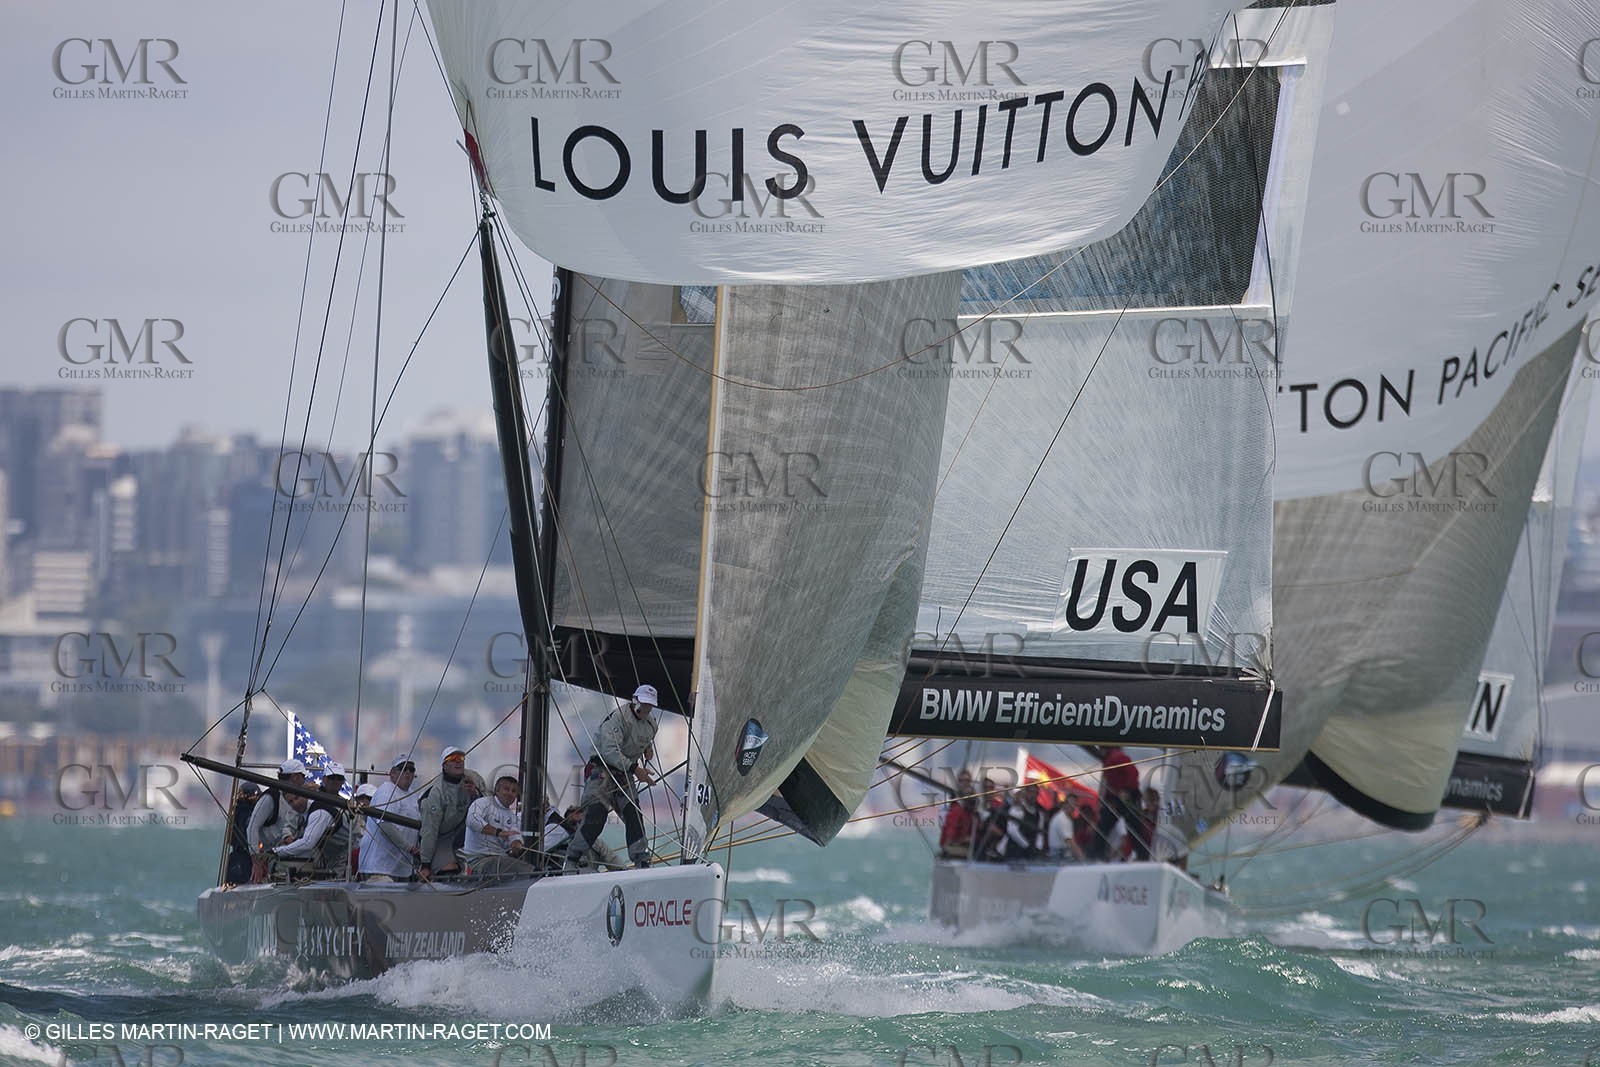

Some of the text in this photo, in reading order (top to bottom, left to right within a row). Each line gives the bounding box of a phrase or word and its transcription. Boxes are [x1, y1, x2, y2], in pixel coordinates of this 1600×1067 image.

[531, 116, 809, 204] LOUIS
[852, 69, 1173, 194] VUITTON
[1278, 369, 1415, 433] TON
[1437, 282, 1561, 406] PACIFIC
[1066, 559, 1199, 633] USA
[920, 687, 1226, 736] BMW EfficientDynamics
[697, 783, 711, 806] 3A
[634, 898, 693, 928] ORACLE
[310, 926, 366, 957] SKYCITY
[385, 931, 465, 958] NEW ZEALAND
